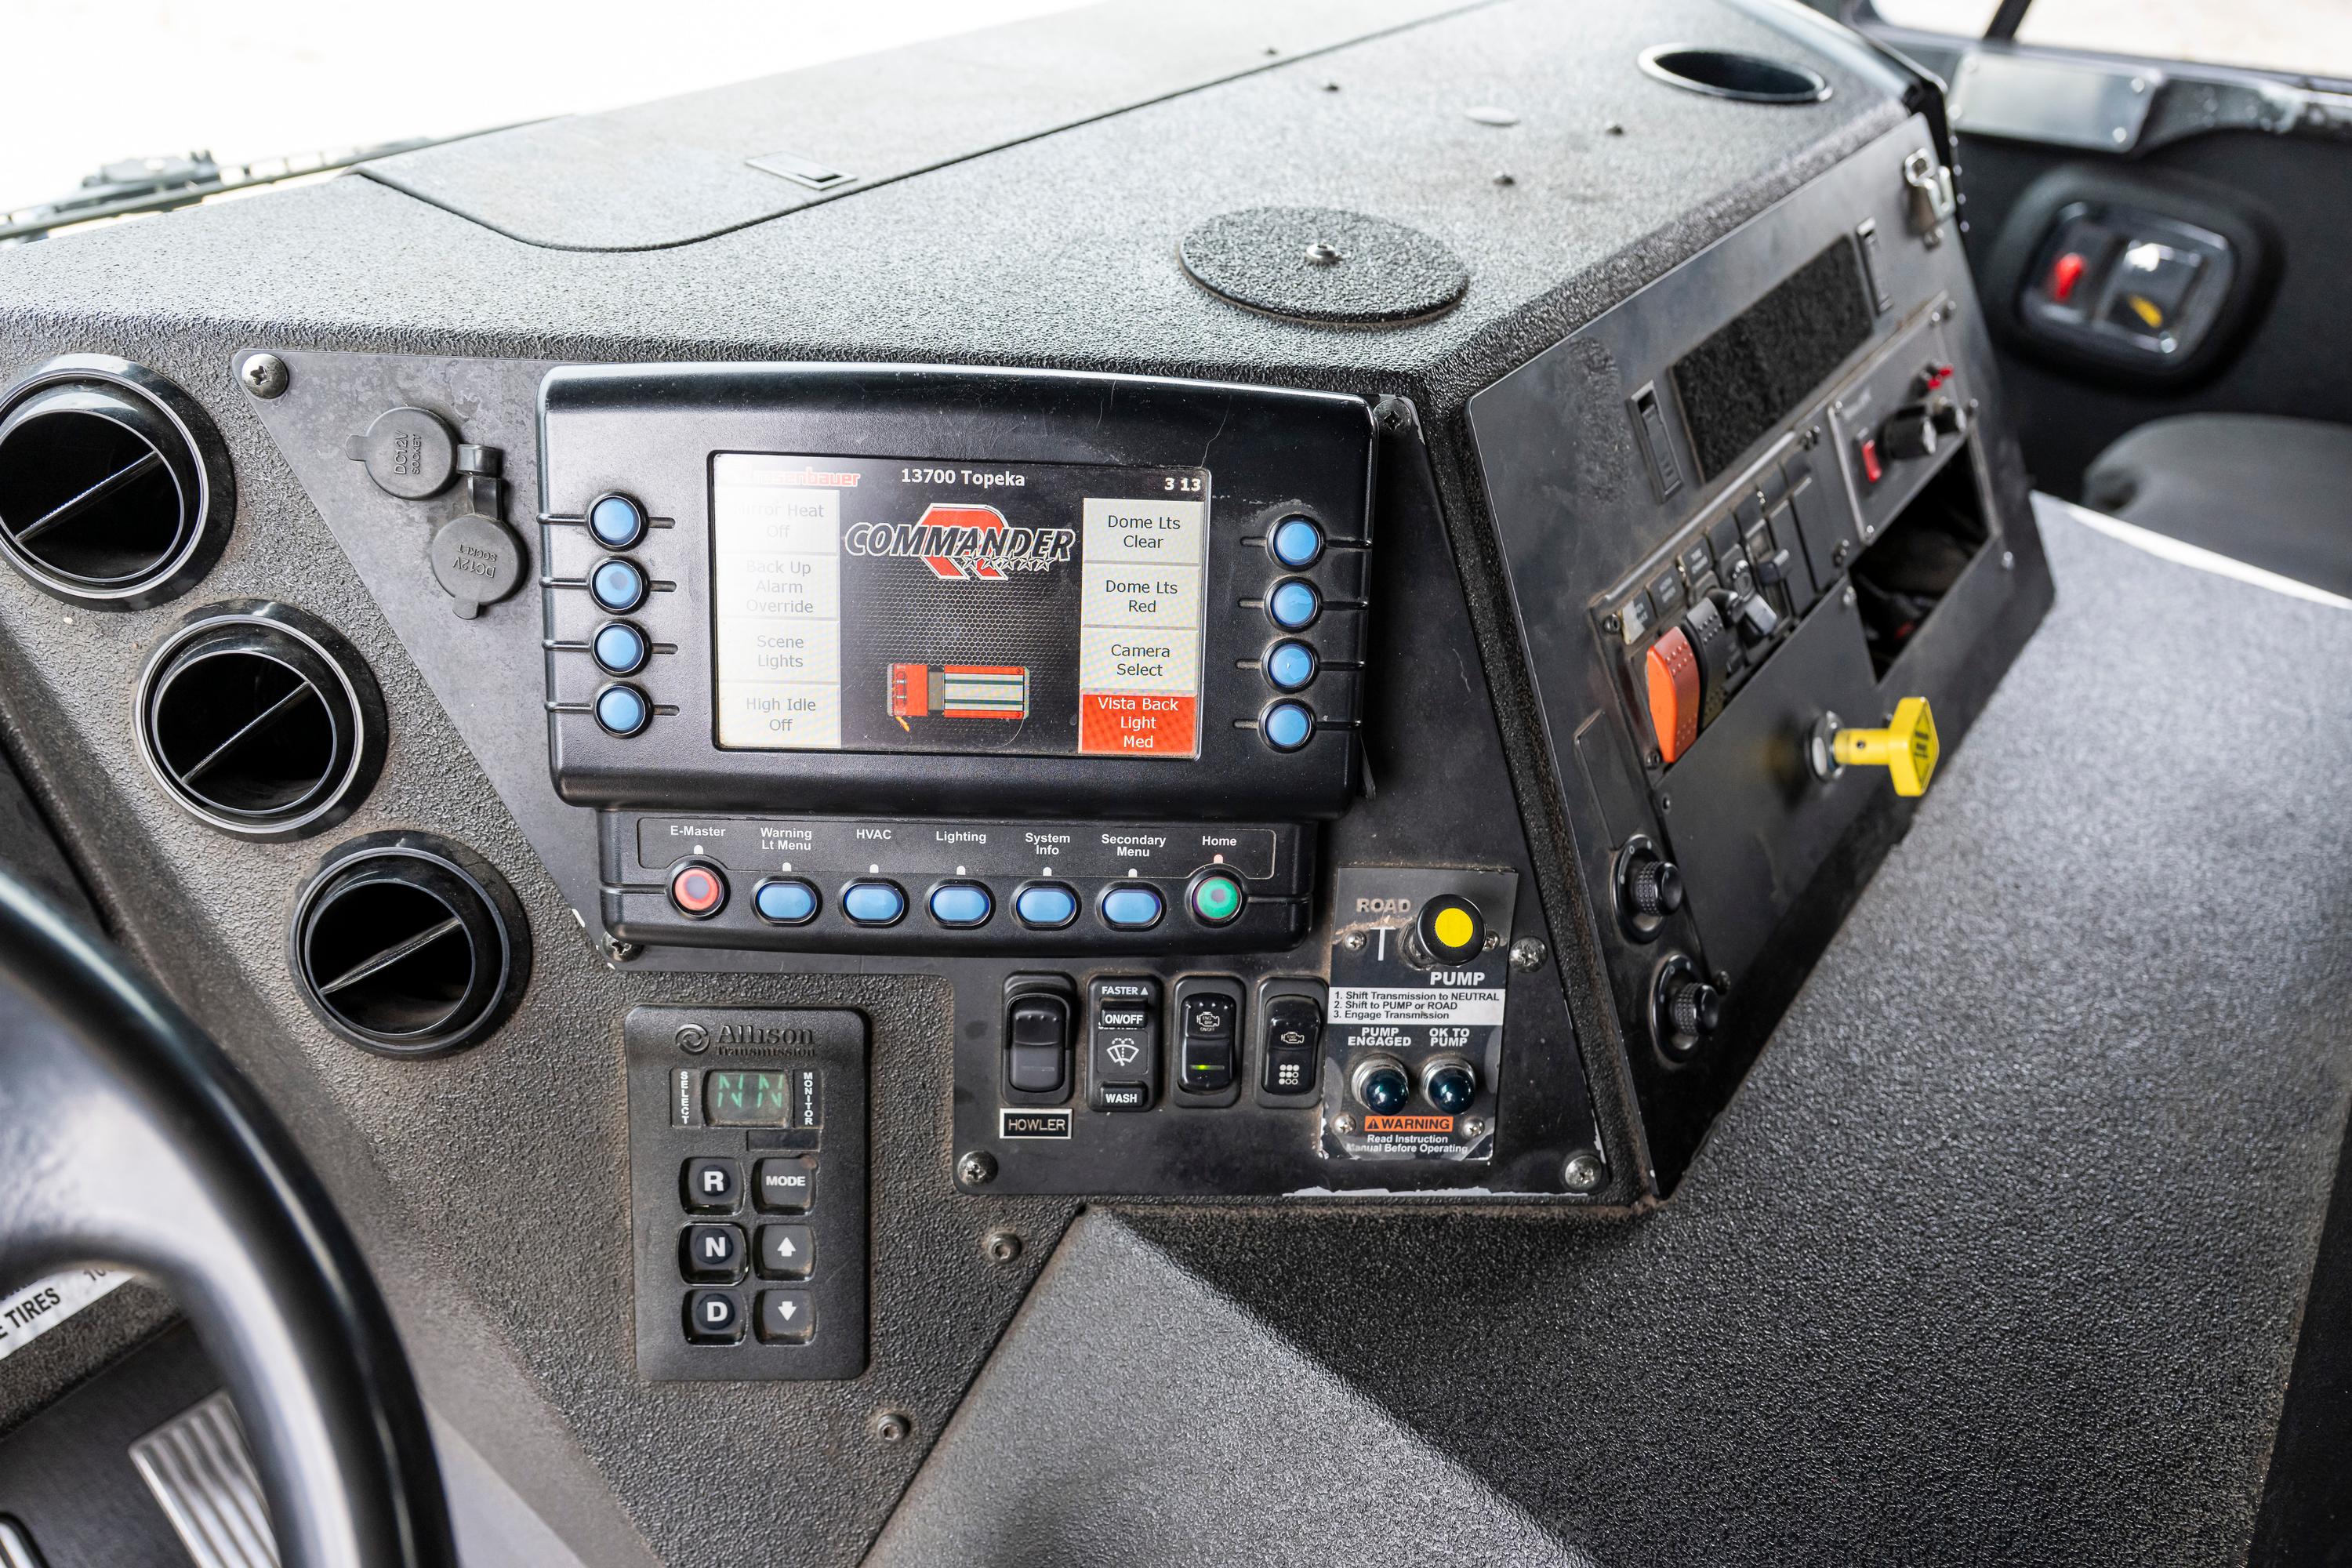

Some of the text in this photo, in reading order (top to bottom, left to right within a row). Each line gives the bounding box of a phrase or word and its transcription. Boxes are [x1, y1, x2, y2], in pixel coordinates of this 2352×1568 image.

[412, 434, 422, 475] SOCKET
[901, 468, 1025, 488] 13700 Topeka
[787, 504, 825, 518] Heat
[1107, 514, 1181, 531] Dome Lts
[767, 524, 790, 539] Off
[844, 521, 1076, 561] COMMANDER
[1123, 534, 1164, 550] Clear
[746, 560, 811, 579] Back Up
[754, 579, 804, 593] Alarm
[1105, 579, 1178, 595] Dome Lts
[746, 598, 814, 615] Override
[1127, 598, 1156, 614] Red
[757, 633, 804, 649] Scene
[1110, 644, 1171, 659] Camera
[757, 653, 804, 671] Lights
[1116, 662, 1163, 678] Select
[746, 697, 816, 714] High Idle
[1097, 696, 1178, 712] Vista Back
[769, 717, 793, 732] Off
[1120, 715, 1157, 731] Light
[1122, 735, 1154, 749] Med
[670, 825, 726, 837] E-Master
[760, 827, 812, 841] Warning
[856, 829, 891, 840] HVAC
[935, 830, 987, 844] Lighting
[761, 839, 811, 851] Lt Menu
[1025, 833, 1071, 846] System
[1101, 833, 1167, 848] Secondary
[1202, 835, 1237, 848] Home
[1036, 844, 1059, 855] Info
[1116, 846, 1150, 858] Menu
[1356, 898, 1411, 913] ROAD
[1430, 971, 1485, 985] PUMP
[1102, 986, 1138, 995] FASTER
[1345, 991, 1370, 1000] Shift
[1371, 991, 1437, 1000] Transmission
[1450, 993, 1500, 1001] NEUTRAL
[1345, 1000, 1368, 1009] Shift
[1382, 1001, 1412, 1010] PUMP
[1105, 1014, 1143, 1025] ON/OFF
[1345, 1011, 1381, 1021] Engage
[1385, 1011, 1450, 1019] Transmission
[717, 1024, 814, 1044] Allison
[1361, 1027, 1399, 1037] PUMP
[1428, 1028, 1470, 1037] OK TO
[1348, 1036, 1412, 1047] ENGAGED
[1430, 1037, 1468, 1047] PUMP
[715, 1046, 815, 1057] Transmission
[680, 1071, 690, 1124] SELECT
[803, 1072, 814, 1125] MONITOR
[1105, 1092, 1138, 1103] WASH
[1007, 1118, 1066, 1131] HOWLER
[1381, 1118, 1450, 1130] WARNING
[1367, 1134, 1448, 1144] Read Instruction
[1346, 1143, 1468, 1154] Manual Before Operating
[704, 1171, 724, 1192] R
[765, 1175, 806, 1187] MODE
[705, 1236, 726, 1258] N
[4, 1287, 61, 1328] TIRES
[706, 1301, 728, 1322] D
